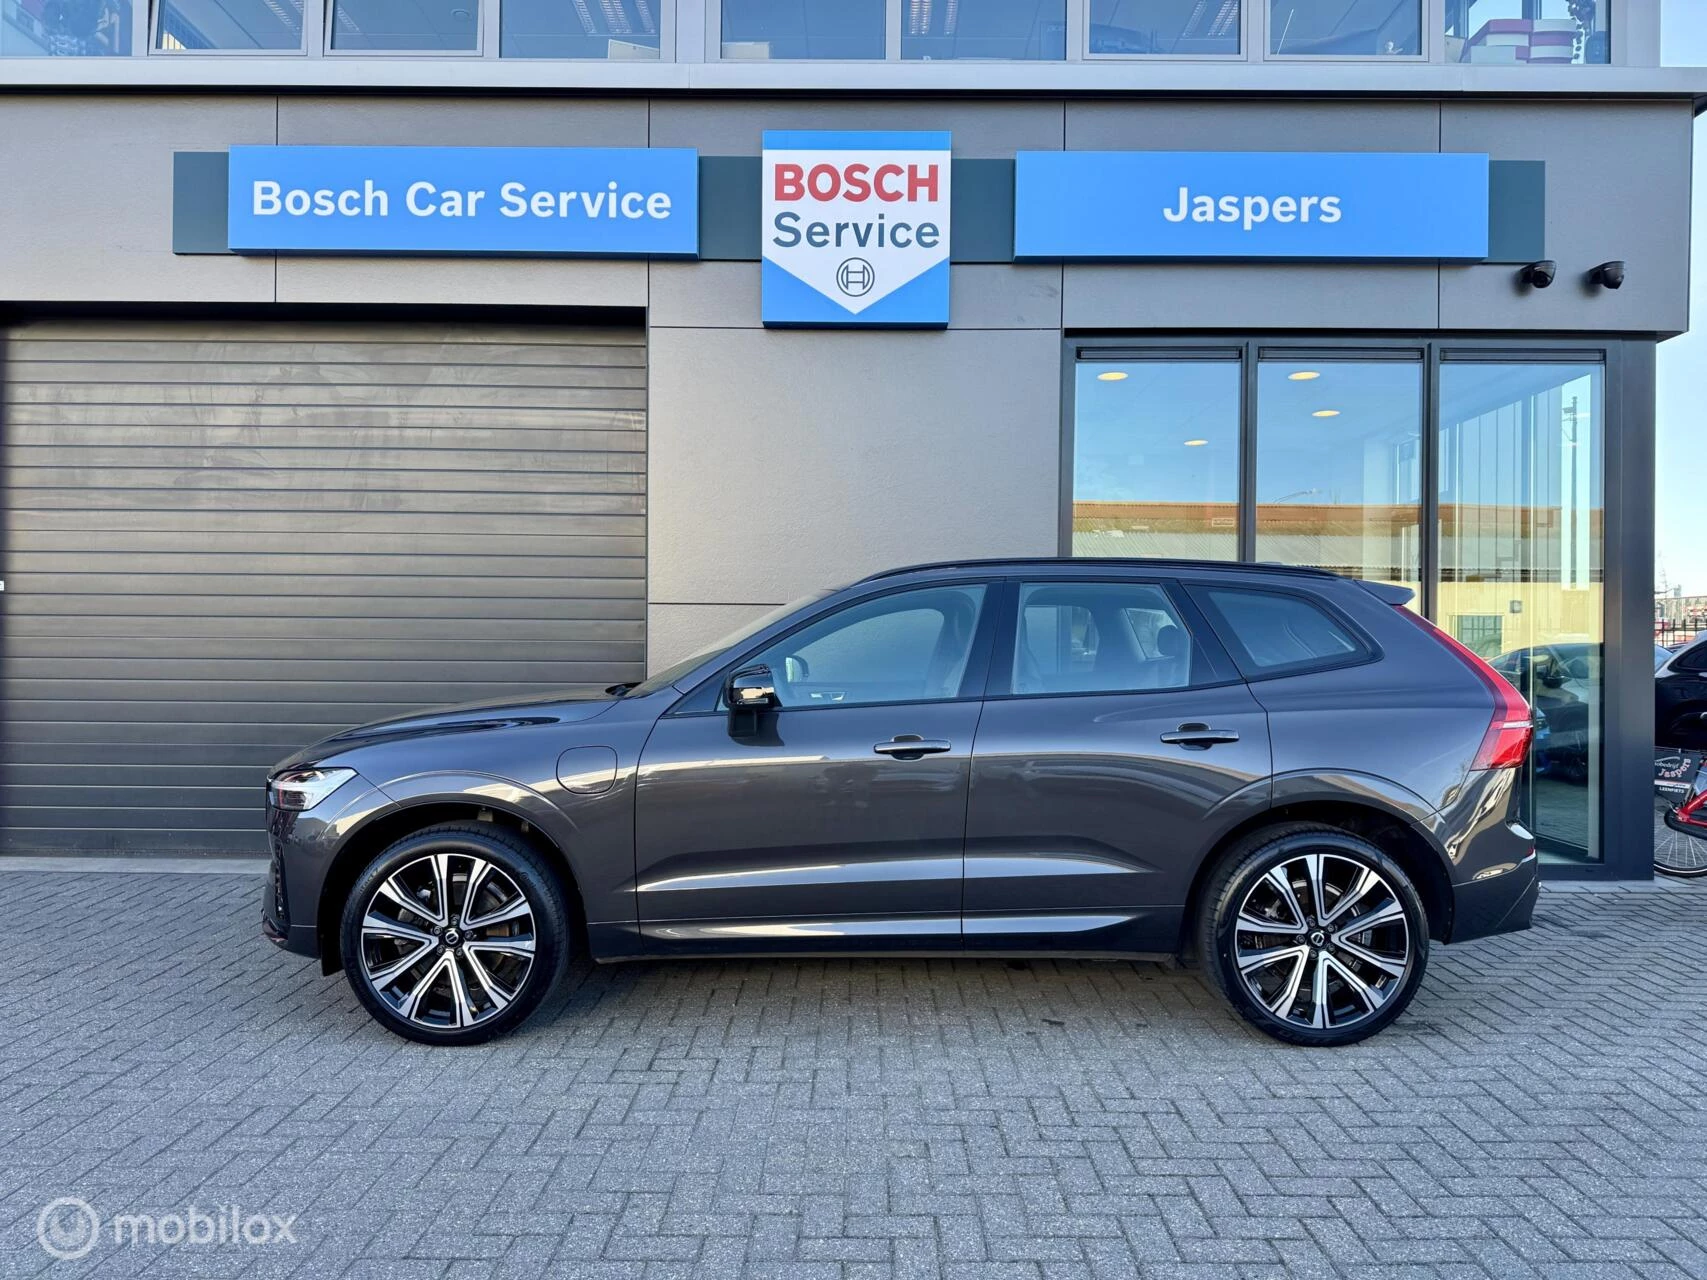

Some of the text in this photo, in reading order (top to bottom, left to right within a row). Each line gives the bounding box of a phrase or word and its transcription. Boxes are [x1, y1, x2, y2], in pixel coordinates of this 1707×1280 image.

[253, 179, 672, 219] Bosch Car Service
[774, 163, 939, 203] BOSCH
[1163, 186, 1342, 231] Jaspers
[772, 211, 940, 249] Service
[1658, 758, 1691, 778] Jaspers
